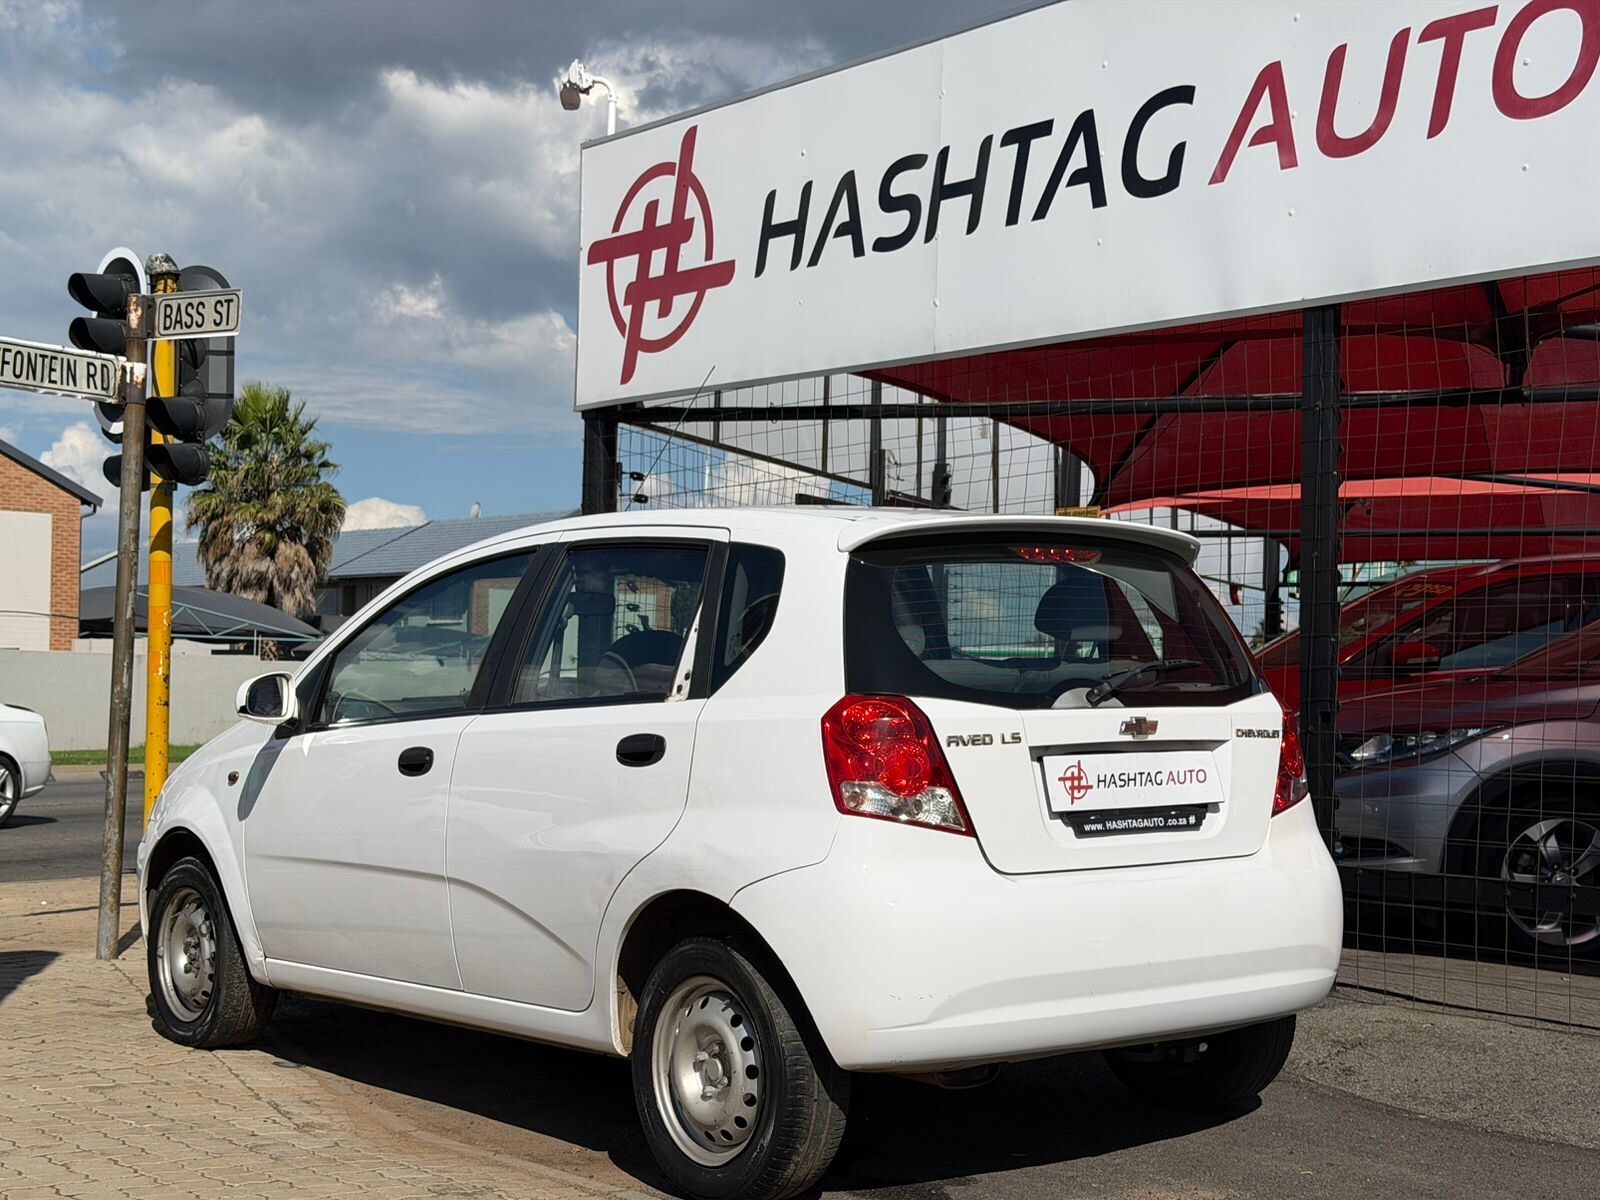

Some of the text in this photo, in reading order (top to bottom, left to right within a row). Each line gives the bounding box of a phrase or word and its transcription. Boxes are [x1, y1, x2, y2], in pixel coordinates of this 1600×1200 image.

[754, 0, 1600, 279] HASHTAG AUTO
[163, 299, 234, 331] BASS ST
[0, 347, 110, 391] FONTEIN RD
[946, 732, 1022, 748] AVEO LS
[1236, 728, 1280, 739] CHEVROLET
[1097, 768, 1207, 789] HASHTAG AUTO
[1083, 823, 1105, 832] www.
[1105, 817, 1165, 830] HASHTAGAUTO
[1166, 817, 1187, 826] .co.za
